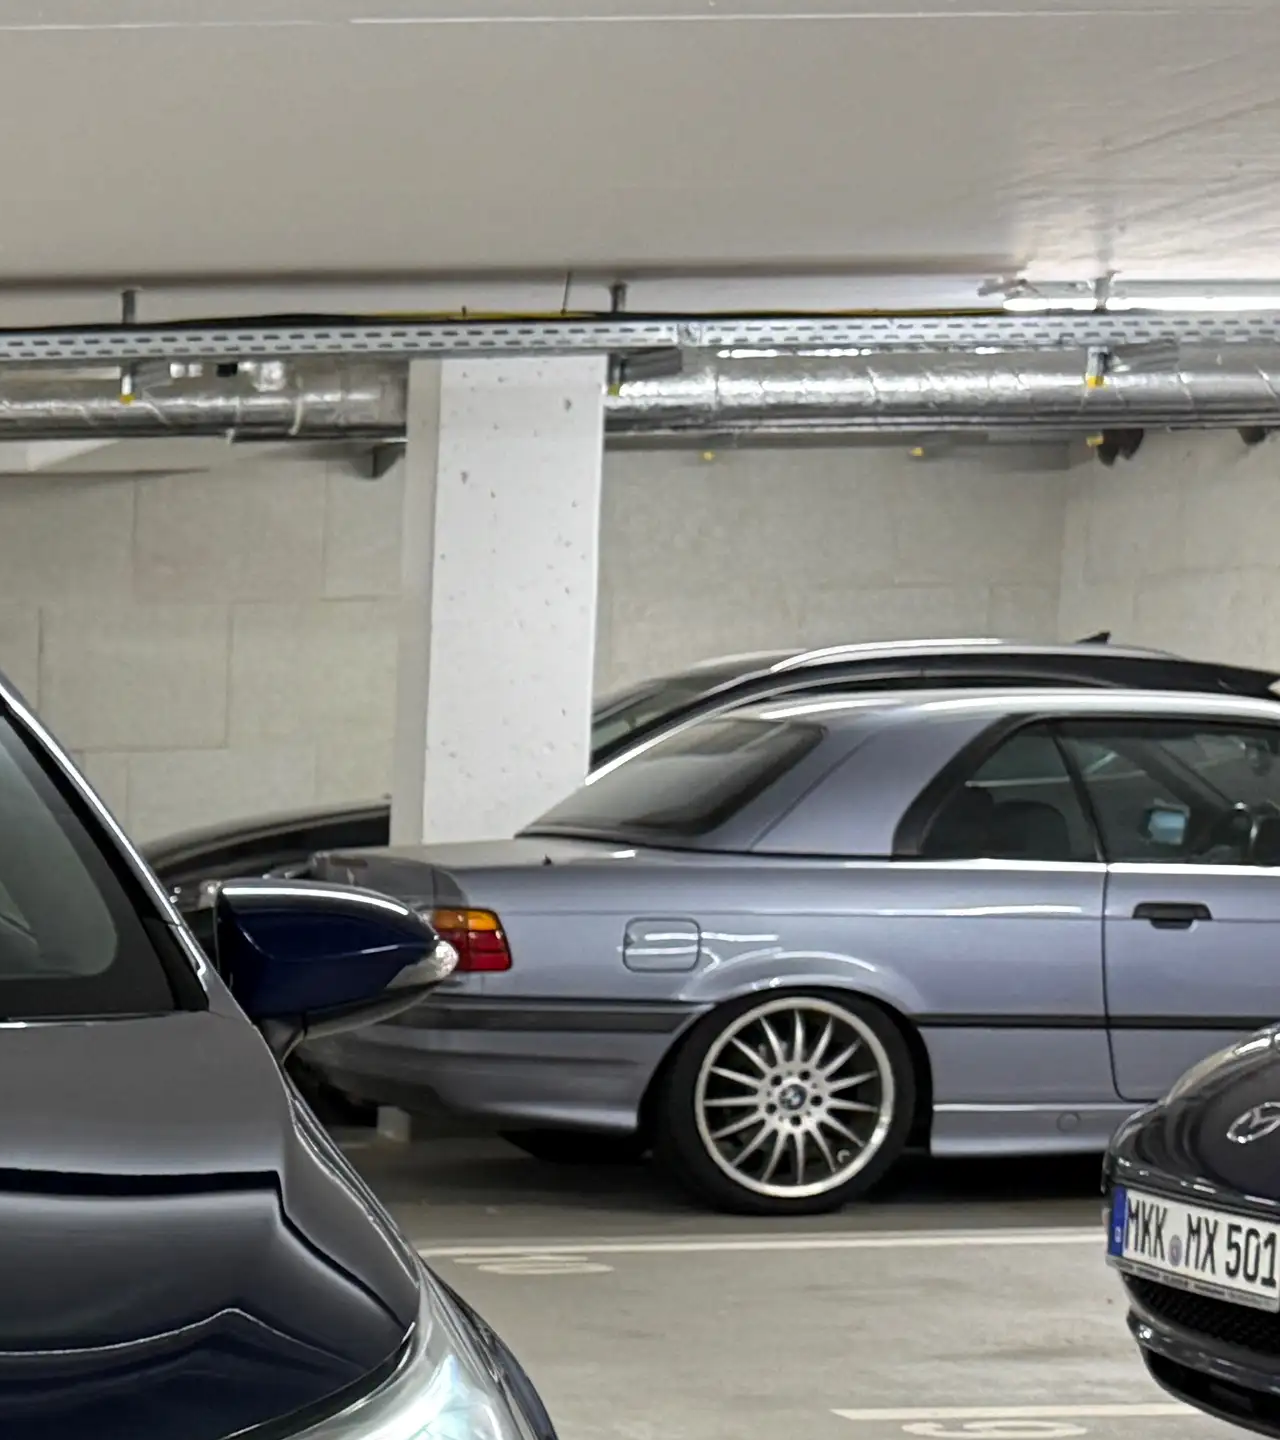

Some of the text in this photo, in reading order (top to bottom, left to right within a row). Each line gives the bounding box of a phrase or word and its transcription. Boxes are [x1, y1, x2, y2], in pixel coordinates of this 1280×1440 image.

[1125, 1197, 1168, 1262] MKK
[1184, 1213, 1219, 1275] MX
[1225, 1223, 1277, 1289] 501
